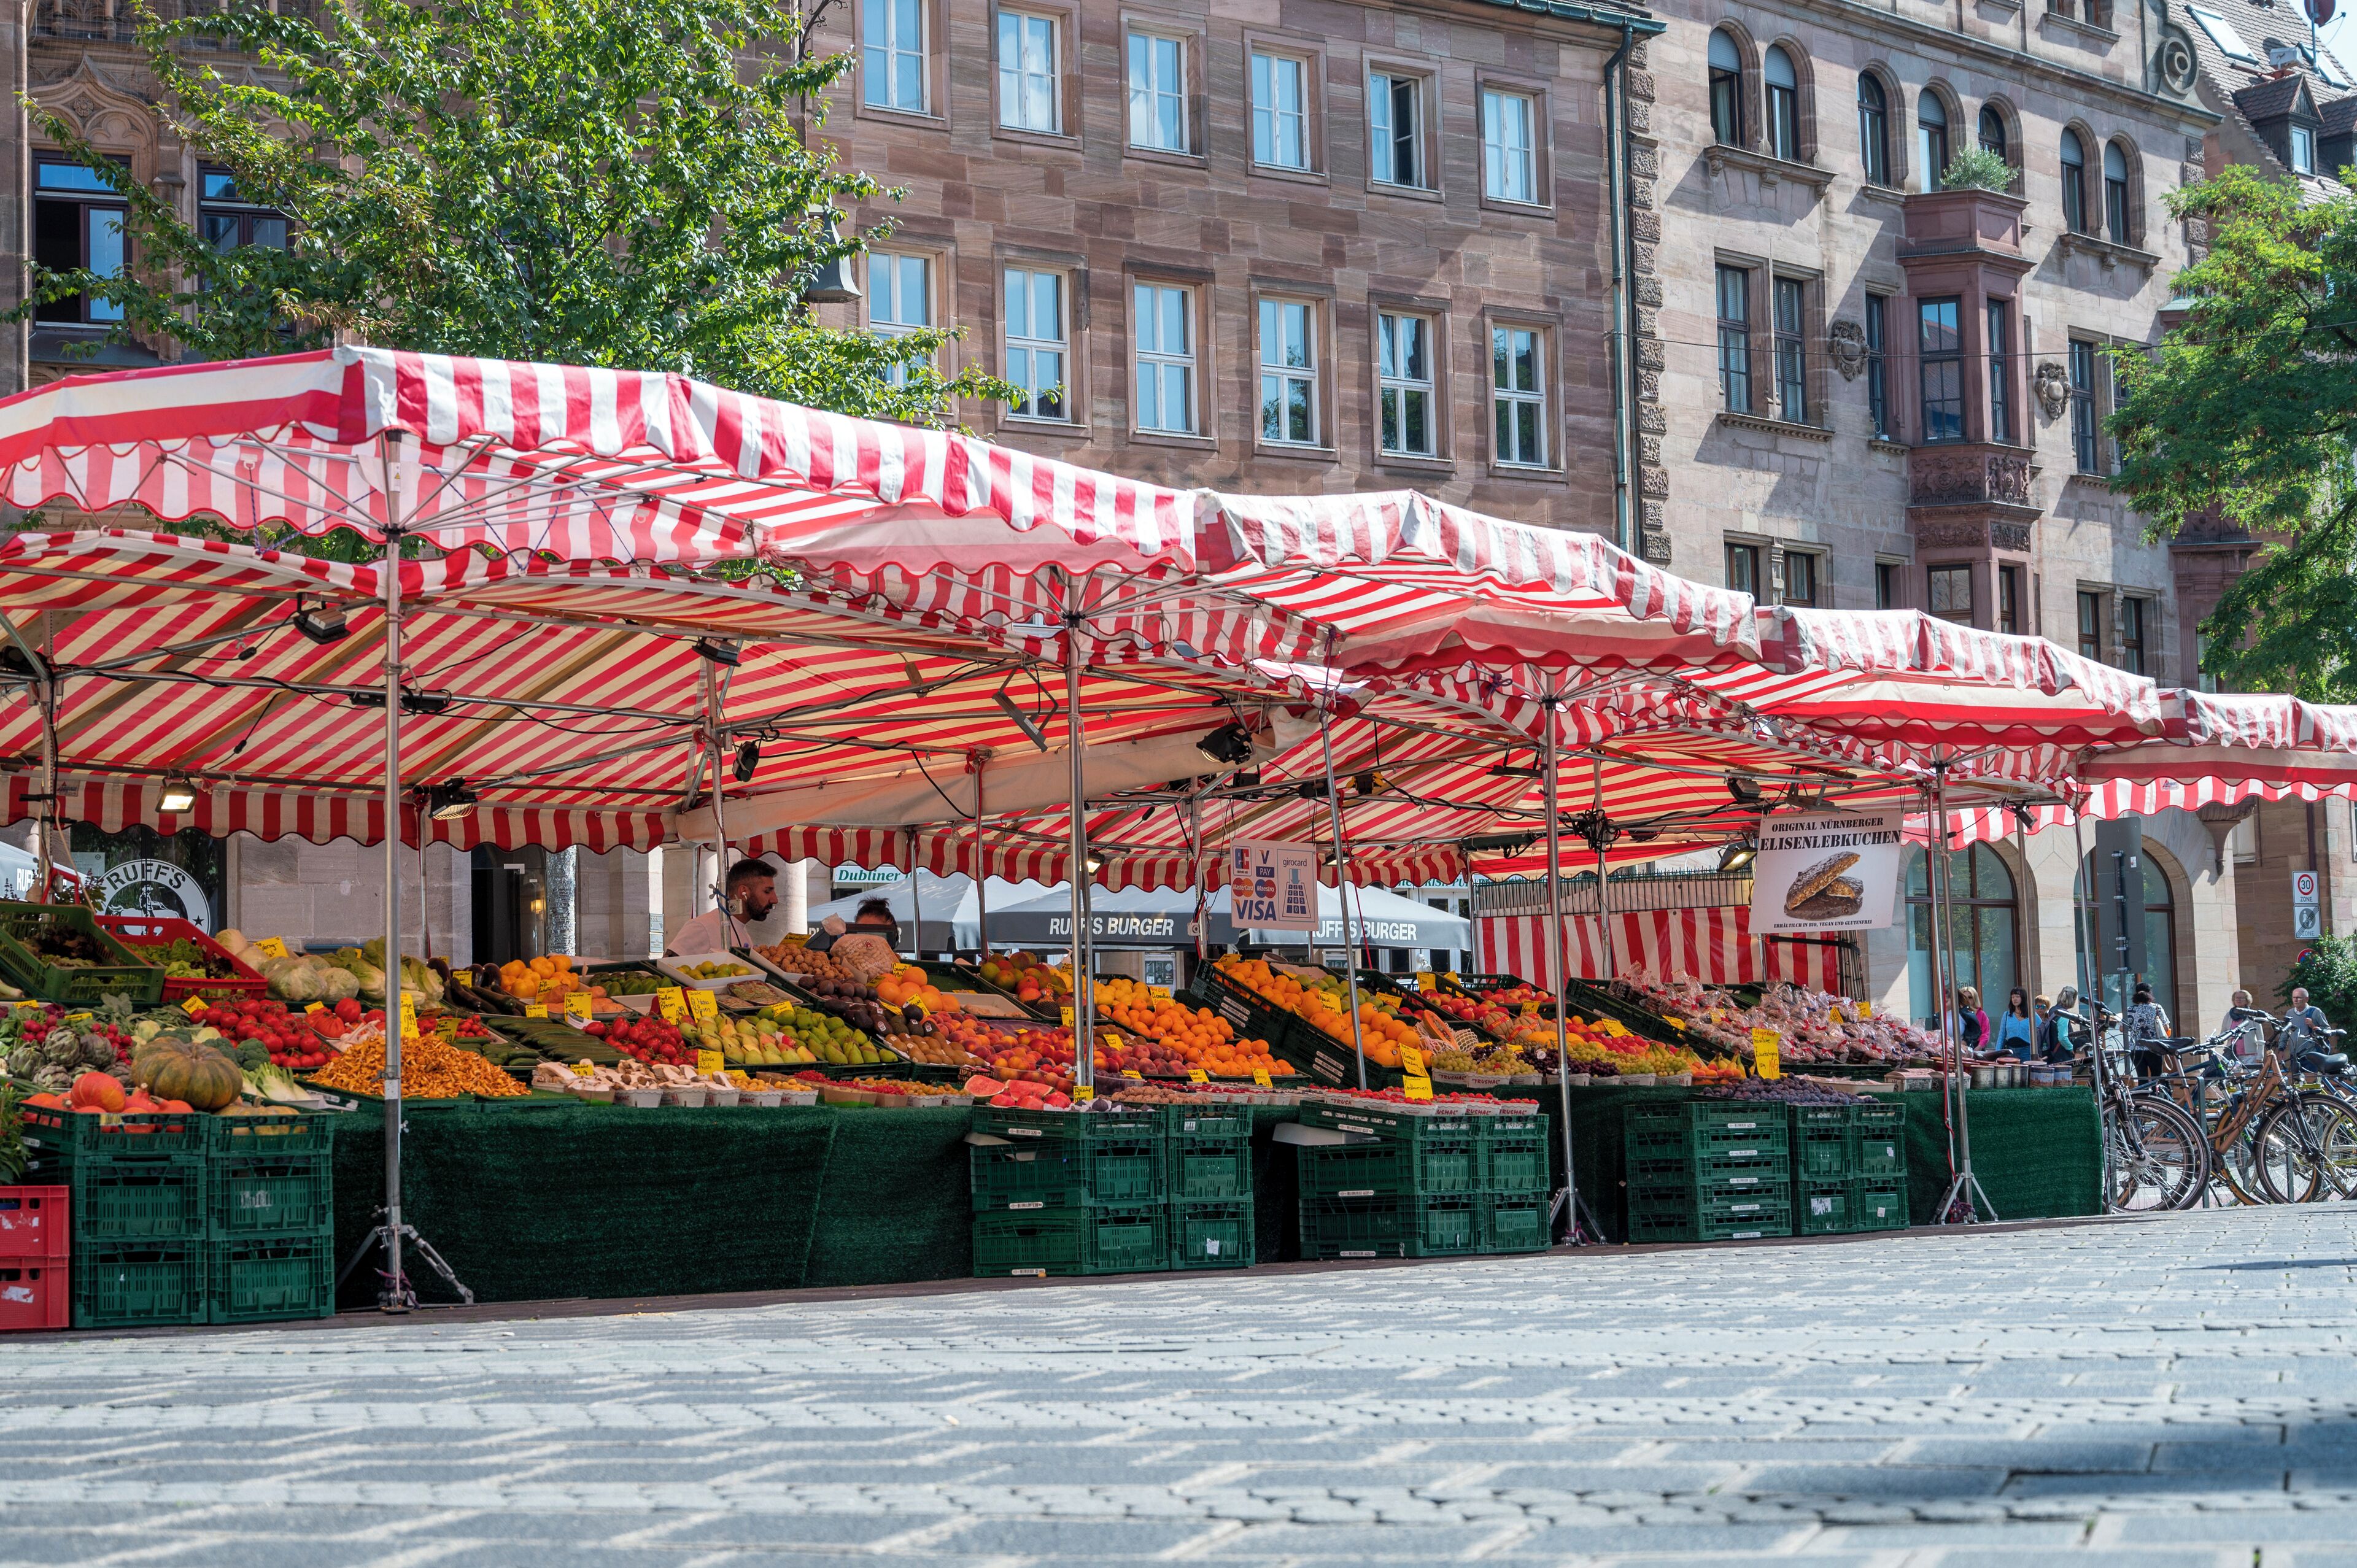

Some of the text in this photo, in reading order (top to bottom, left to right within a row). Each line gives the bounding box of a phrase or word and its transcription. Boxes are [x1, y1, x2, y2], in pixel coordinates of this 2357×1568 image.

[1772, 817, 1884, 833] ORIGINAL NÜRNBERGER
[1760, 830, 1902, 851] ELISENLEBKUCHEN
[1283, 857, 1307, 868] girocard
[106, 862, 185, 890] RUFF'S
[838, 869, 900, 881] Dubliner
[2301, 879, 2311, 890] 30
[1233, 899, 1277, 921] VISA
[1107, 917, 1174, 936] BURGER
[1361, 922, 1417, 941] BURGER
